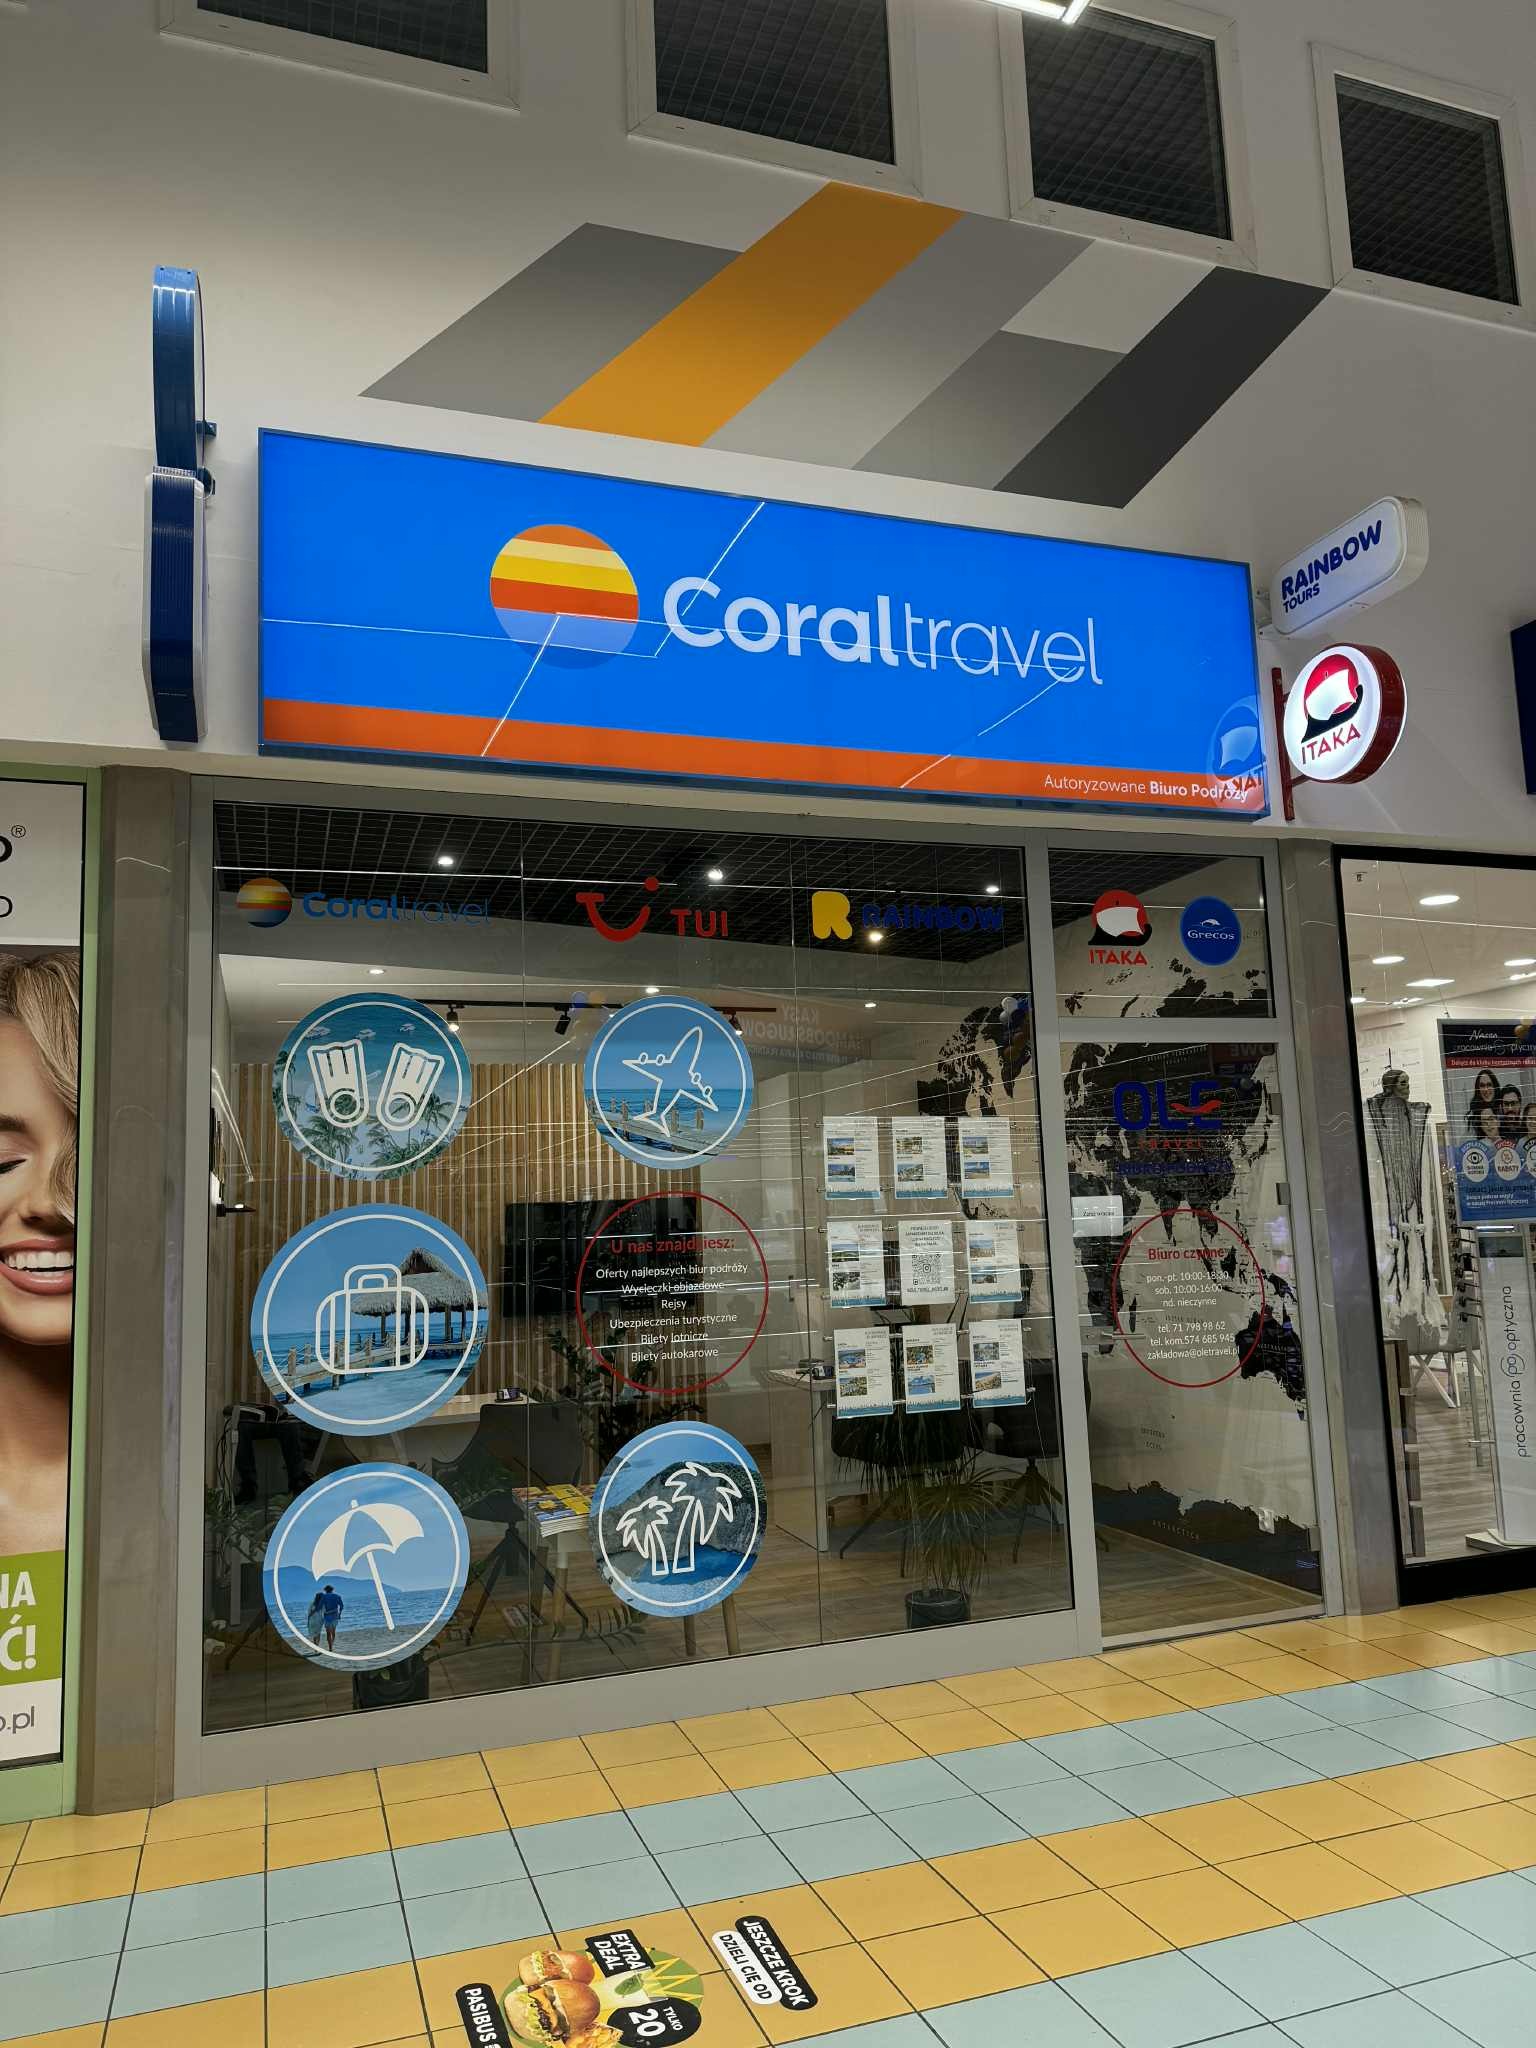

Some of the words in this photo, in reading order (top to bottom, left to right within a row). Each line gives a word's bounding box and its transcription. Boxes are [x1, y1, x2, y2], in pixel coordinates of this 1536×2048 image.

[1281, 519, 1382, 601] RAINBOW
[1283, 583, 1320, 613] TOURS
[662, 576, 1104, 686] Coraltravel
[1301, 723, 1361, 765] ITAKA
[1044, 775, 1146, 794] Autoryzowane
[1150, 780, 1198, 797] Biuro
[1201, 783, 1258, 803] Podróży
[670, 908, 729, 938] TUI
[862, 903, 1004, 930] RAINBOW
[1187, 929, 1236, 941] Grecos
[1089, 949, 1148, 965] ITAKA
[1138, 1136, 1202, 1150] TRAVEL
[611, 1240, 623, 1254] U
[628, 1241, 653, 1253] nas
[656, 1237, 736, 1253] znajdiesz:
[1148, 1248, 1180, 1261] Biuro
[1183, 1247, 1225, 1261] czynne
[596, 1269, 629, 1279] Oferty
[631, 1265, 687, 1278] najlepszych
[689, 1264, 707, 1275] biur
[710, 1263, 748, 1275] podróży
[621, 1284, 671, 1295] Wycieczki
[673, 1281, 725, 1293] objazdowe
[1154, 1285, 1172, 1295] sob.
[661, 1299, 687, 1310] Rejsy
[1177, 1297, 1217, 1308] nieczynne
[609, 1316, 680, 1329] Ubezpieczenia
[682, 1313, 738, 1326] turystyczne
[1158, 1324, 1171, 1333] tel.
[1172, 1323, 1183, 1333] 71
[1186, 1322, 1201, 1333] 798
[1203, 1322, 1214, 1332] 98
[1215, 1321, 1226, 1331] 62
[1502, 1285, 1521, 1350] optyczna
[641, 1333, 668, 1345] Bilety
[671, 1331, 709, 1343] lotnicze
[1150, 1337, 1163, 1346] tel.
[1202, 1334, 1218, 1344] 685
[1219, 1333, 1236, 1343] 945
[631, 1352, 659, 1363] Bilety
[661, 1348, 719, 1359] autokarowe
[1509, 1380, 1532, 1458] pracownia
[593, 1940, 624, 1970] DEAL
[610, 1933, 647, 1970] EXTRA
[743, 1921, 786, 1970] JESZCZE
[772, 1969, 810, 2007] KROK
[719, 1934, 750, 1964] DZIELI
[740, 1965, 762, 1983] CIĘ
[753, 1983, 773, 1999] OD
[465, 1987, 497, 2043] PASIBUS
[628, 2008, 666, 2037] 20
[663, 2006, 684, 2031] TYLKO
